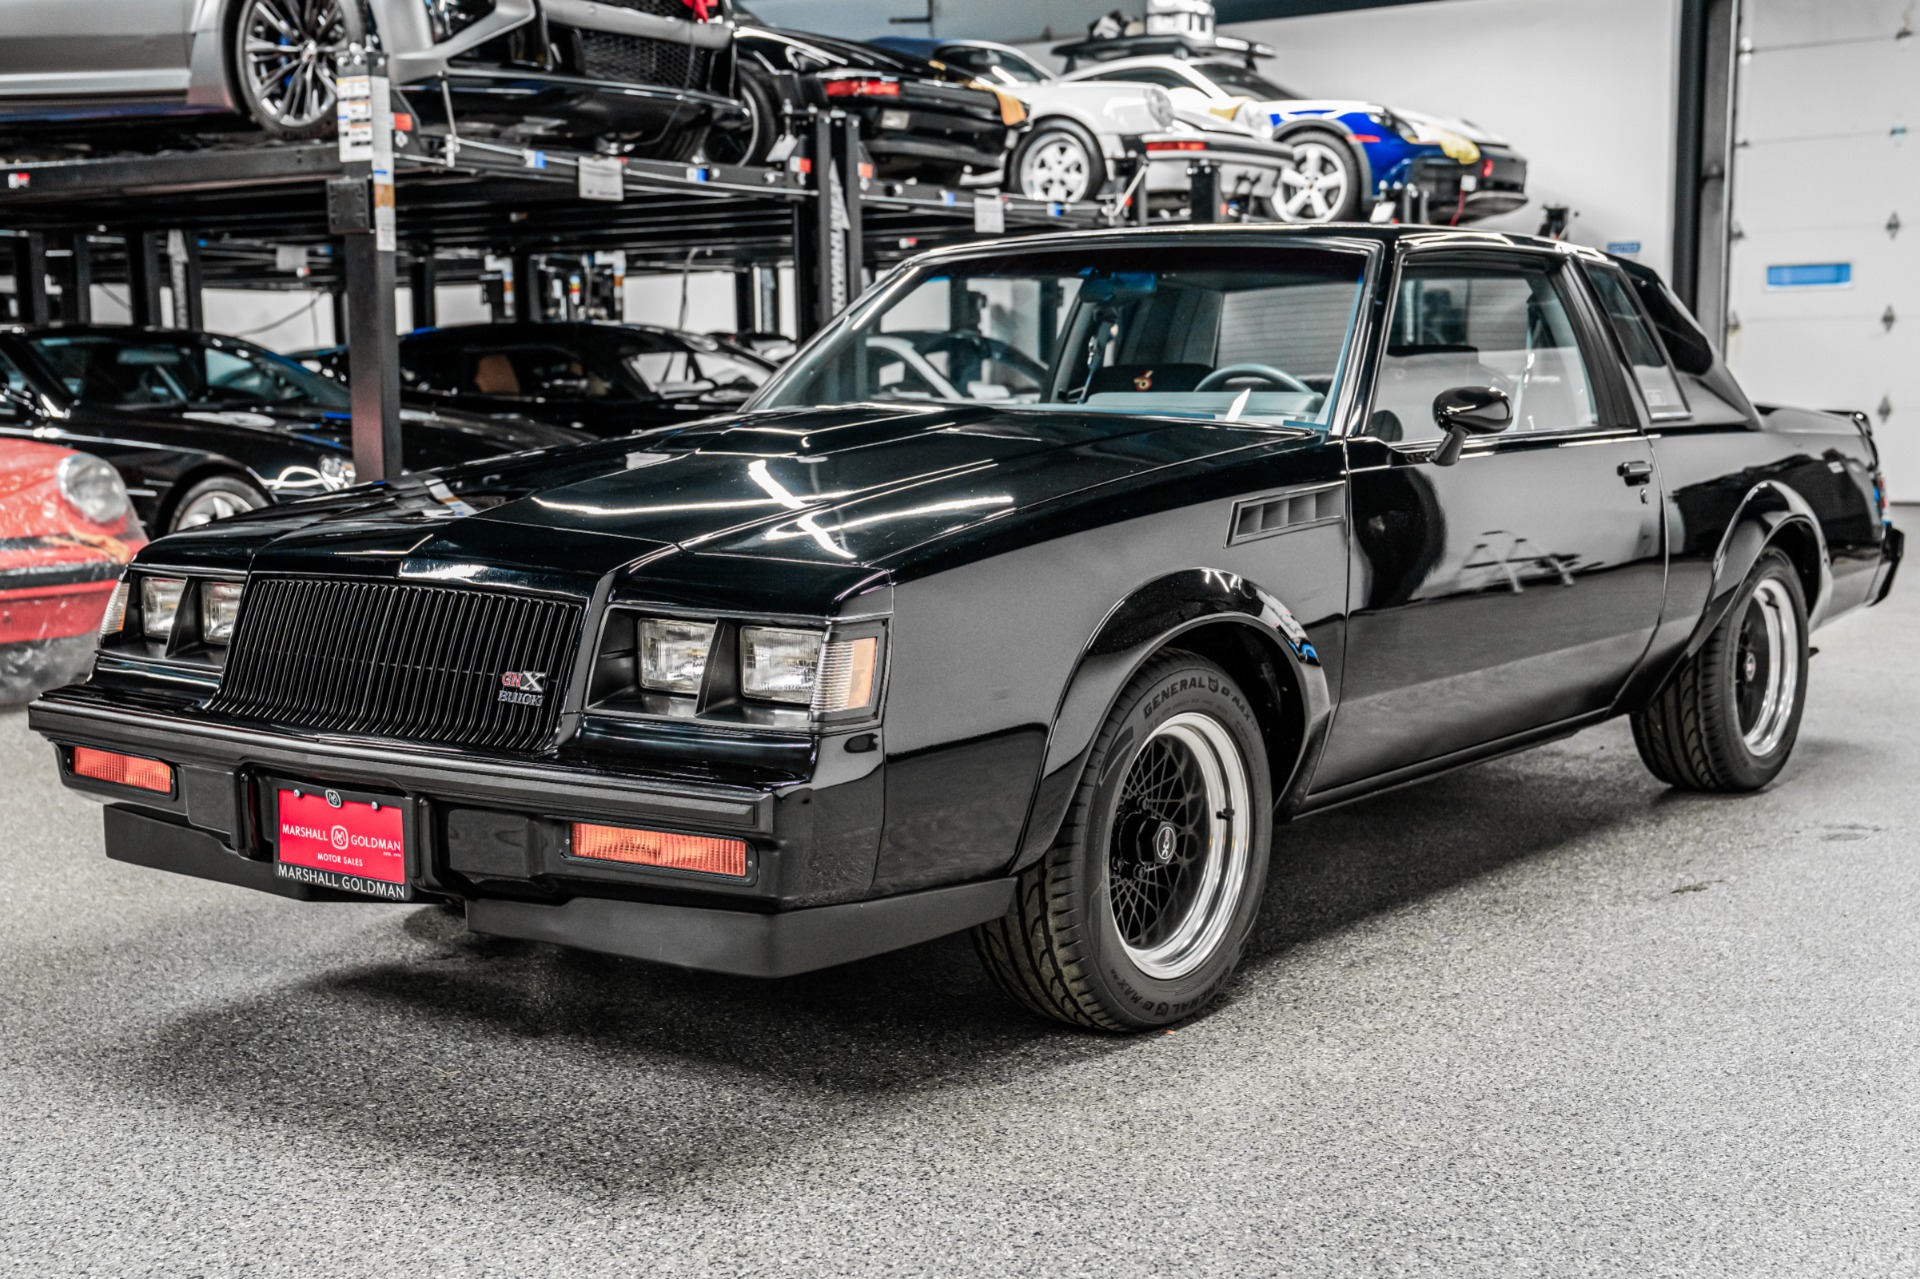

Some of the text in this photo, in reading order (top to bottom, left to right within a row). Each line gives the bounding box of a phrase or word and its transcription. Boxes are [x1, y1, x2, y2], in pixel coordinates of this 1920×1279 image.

[501, 671, 547, 692] GNX
[498, 690, 543, 707] BUICK
[1143, 676, 1206, 720] GENERAL
[282, 823, 329, 842] MARSHALL
[350, 834, 401, 852] GOLDMAN
[317, 852, 363, 867] MOTOR SALES
[278, 864, 405, 899] MARSHALL GOLDMAN
